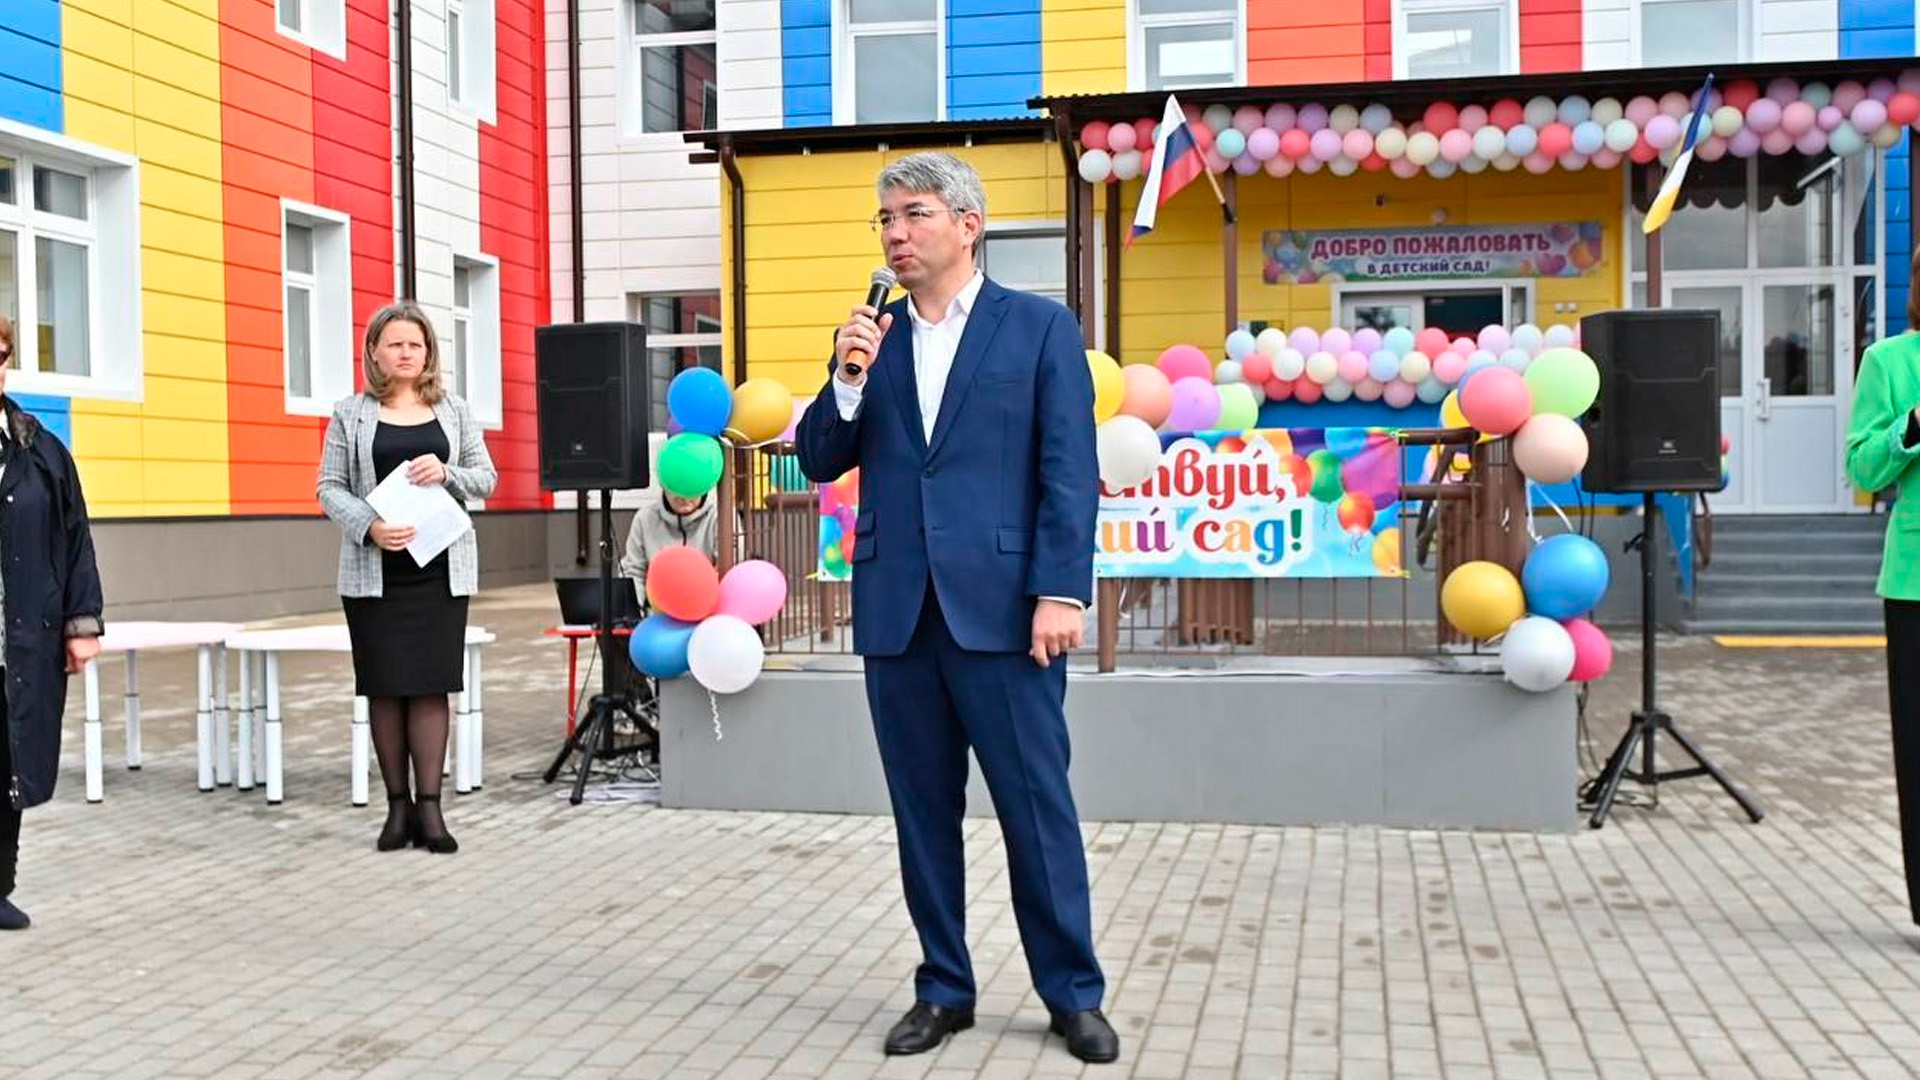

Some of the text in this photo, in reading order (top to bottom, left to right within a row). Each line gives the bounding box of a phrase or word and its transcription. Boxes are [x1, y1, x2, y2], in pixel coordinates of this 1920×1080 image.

[1311, 233, 1550, 260] ДОБРО ПОЖАЛОВАТЬ
[1380, 259, 1449, 275] ДЕТСКИЙ
[1453, 260, 1490, 273] САД!
[1193, 508, 1303, 566] сад!
